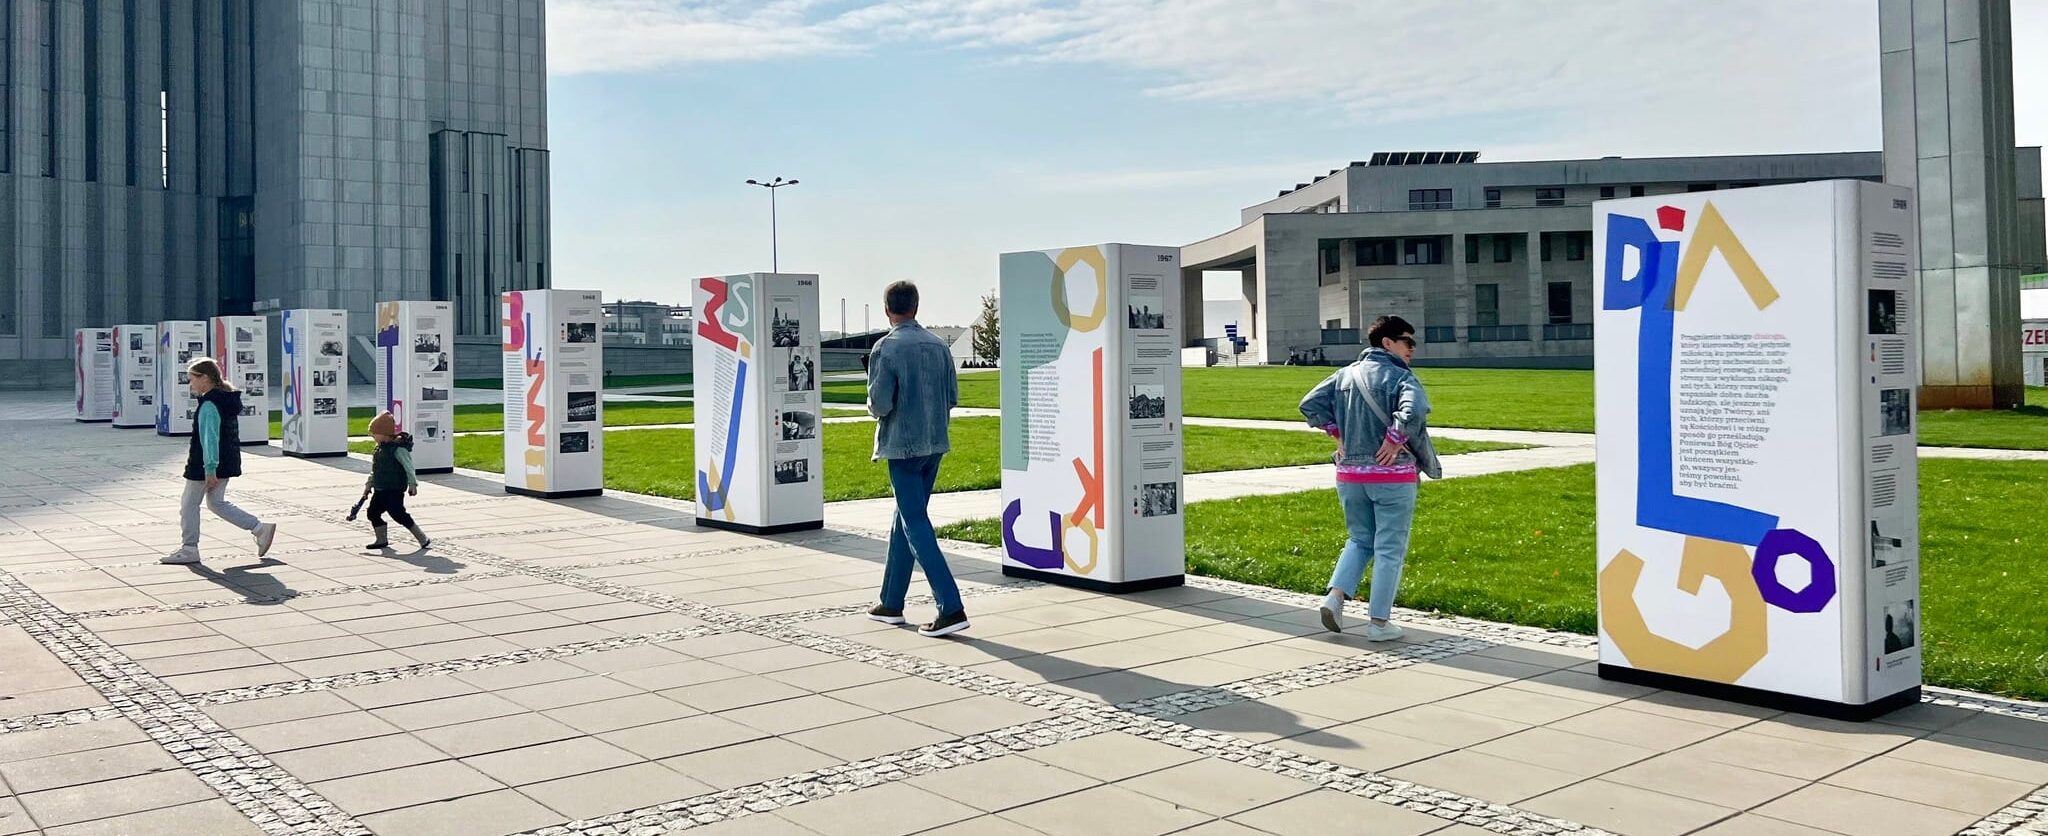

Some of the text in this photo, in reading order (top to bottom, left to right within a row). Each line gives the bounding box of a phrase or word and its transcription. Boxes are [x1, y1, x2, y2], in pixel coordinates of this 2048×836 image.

[1157, 254, 1173, 262] 1967
[2021, 329, 2048, 345] ZE
[1700, 415, 1723, 424] którzy
[1679, 439, 1758, 449] Ponieważ Bóg Ojciec
[1692, 465, 1724, 473] wszyscy
[1724, 465, 1740, 473] jes-
[1679, 472, 1702, 480] teśmy
[1679, 480, 1692, 488] aby
[1694, 480, 1707, 488] być
